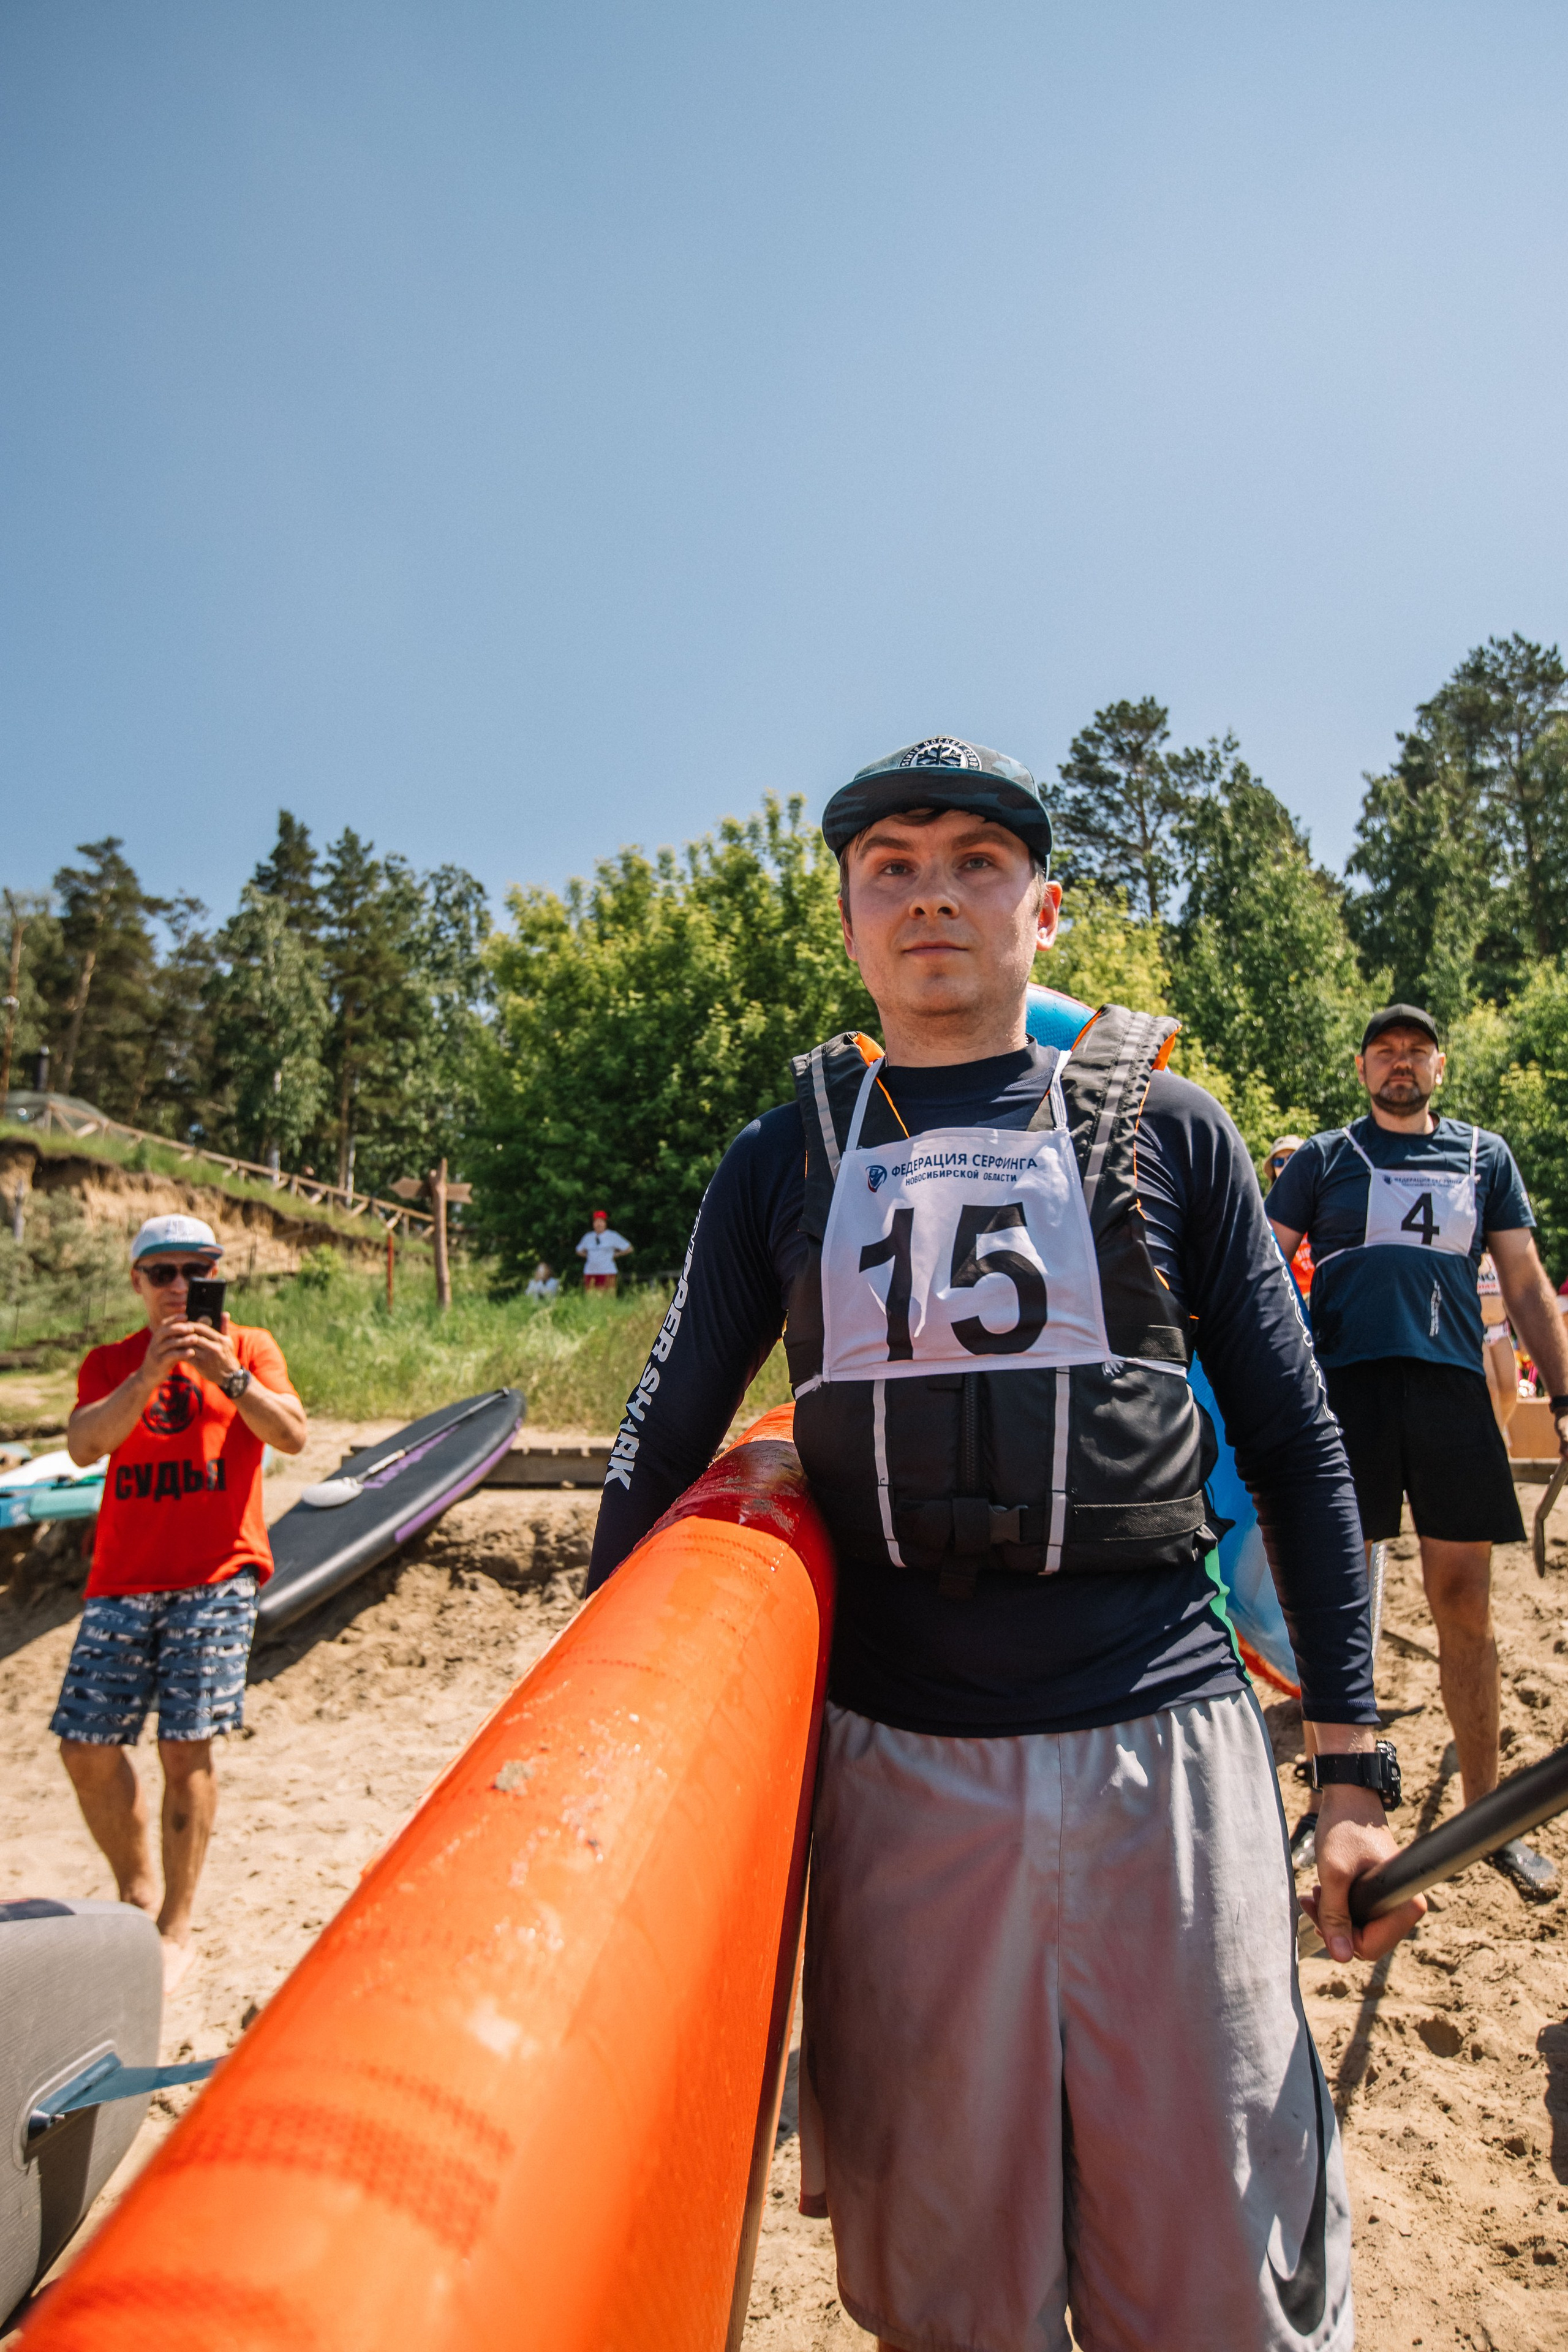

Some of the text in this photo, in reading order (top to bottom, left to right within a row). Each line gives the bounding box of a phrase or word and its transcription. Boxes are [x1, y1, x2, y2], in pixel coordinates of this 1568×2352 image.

[923, 737, 965, 750] HOCKEY
[963, 748, 979, 767] CLUB
[891, 1153, 1038, 1177] ФЕДЕРАЦИЯ СЕРФИНГА
[905, 1169, 1017, 1186] НОВОСИБИРСКОЙ ОБЛАСТИ
[1400, 1192, 1440, 1246] 4
[858, 1201, 1048, 1362] 15
[115, 1457, 227, 1503] СУДЬЯ
